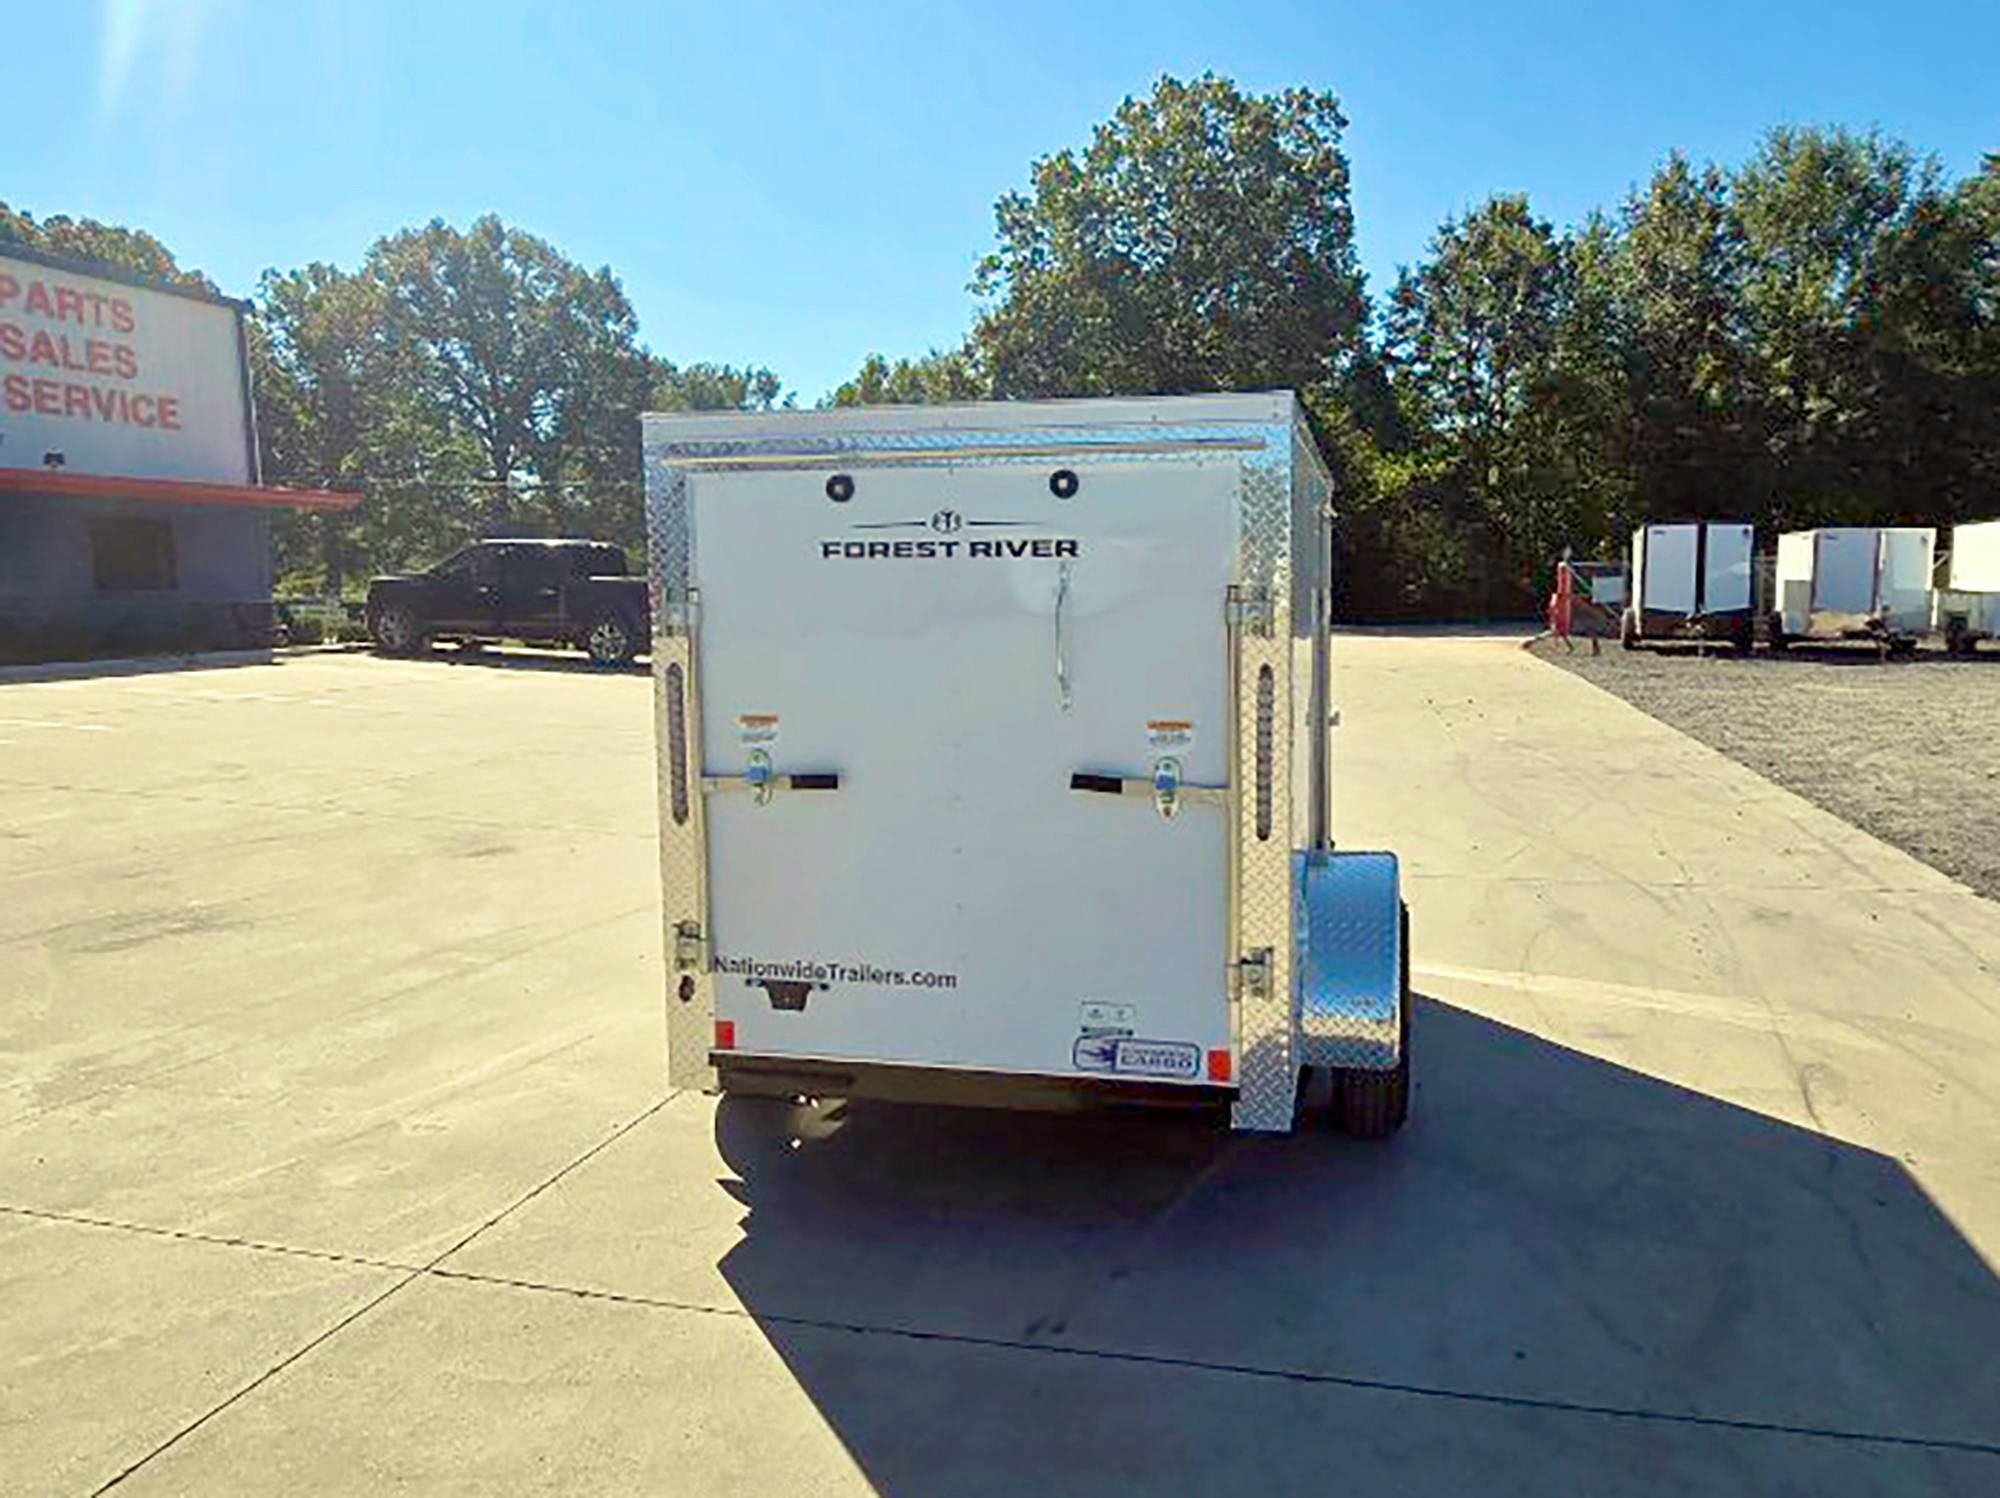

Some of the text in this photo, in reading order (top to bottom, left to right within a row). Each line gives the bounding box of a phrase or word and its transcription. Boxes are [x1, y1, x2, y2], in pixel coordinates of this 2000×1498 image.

[0, 274, 135, 333] PARTS
[0, 322, 138, 379] SALES
[3, 374, 181, 430] SERVICE
[820, 539, 1080, 559] FOREST RIVER
[713, 955, 957, 989] NationwideTrailers.com
